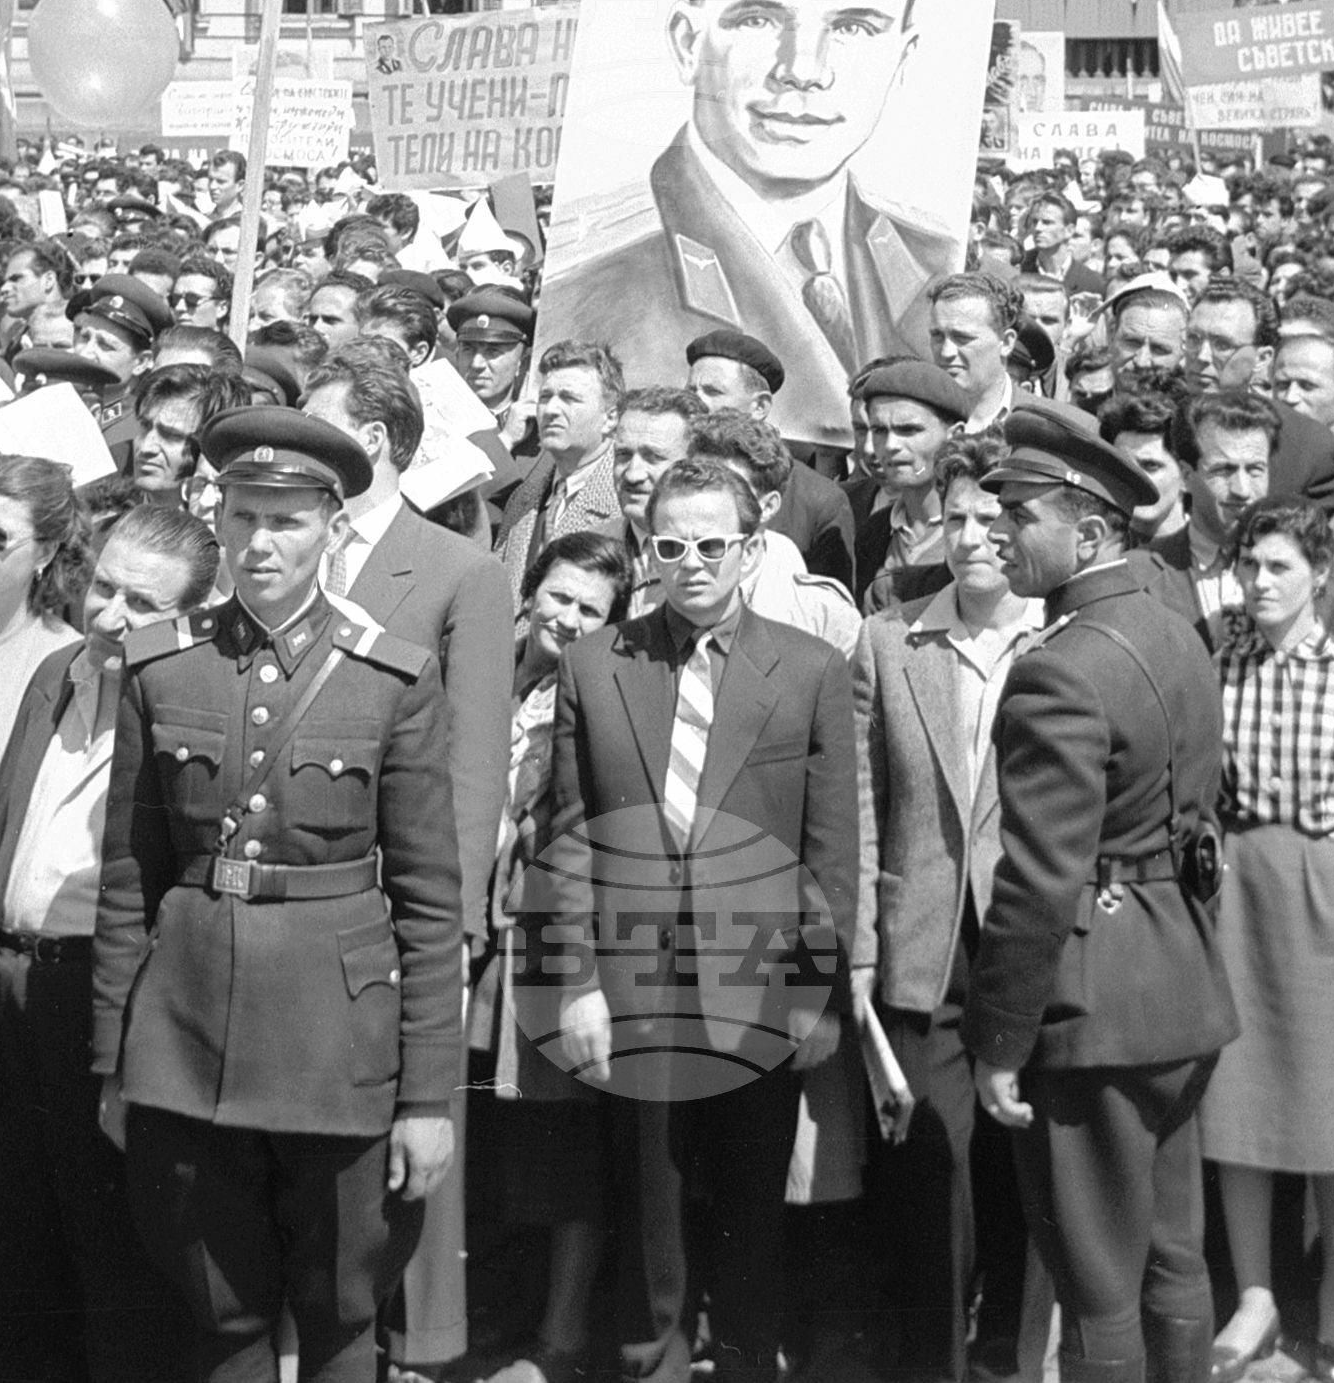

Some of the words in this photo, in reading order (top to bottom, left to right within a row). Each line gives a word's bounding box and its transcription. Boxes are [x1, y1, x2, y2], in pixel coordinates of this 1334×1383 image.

[408, 20, 540, 73] СЛАВА
[1213, 20, 1241, 46] ДА
[1250, 10, 1325, 41] ЖИВЕЕ
[382, 83, 414, 126] ТЕ
[1033, 123, 1117, 137] СЛАВА
[387, 132, 455, 175] ТЕЛИ
[462, 129, 501, 171] НА
[1018, 147, 1041, 160] НА
